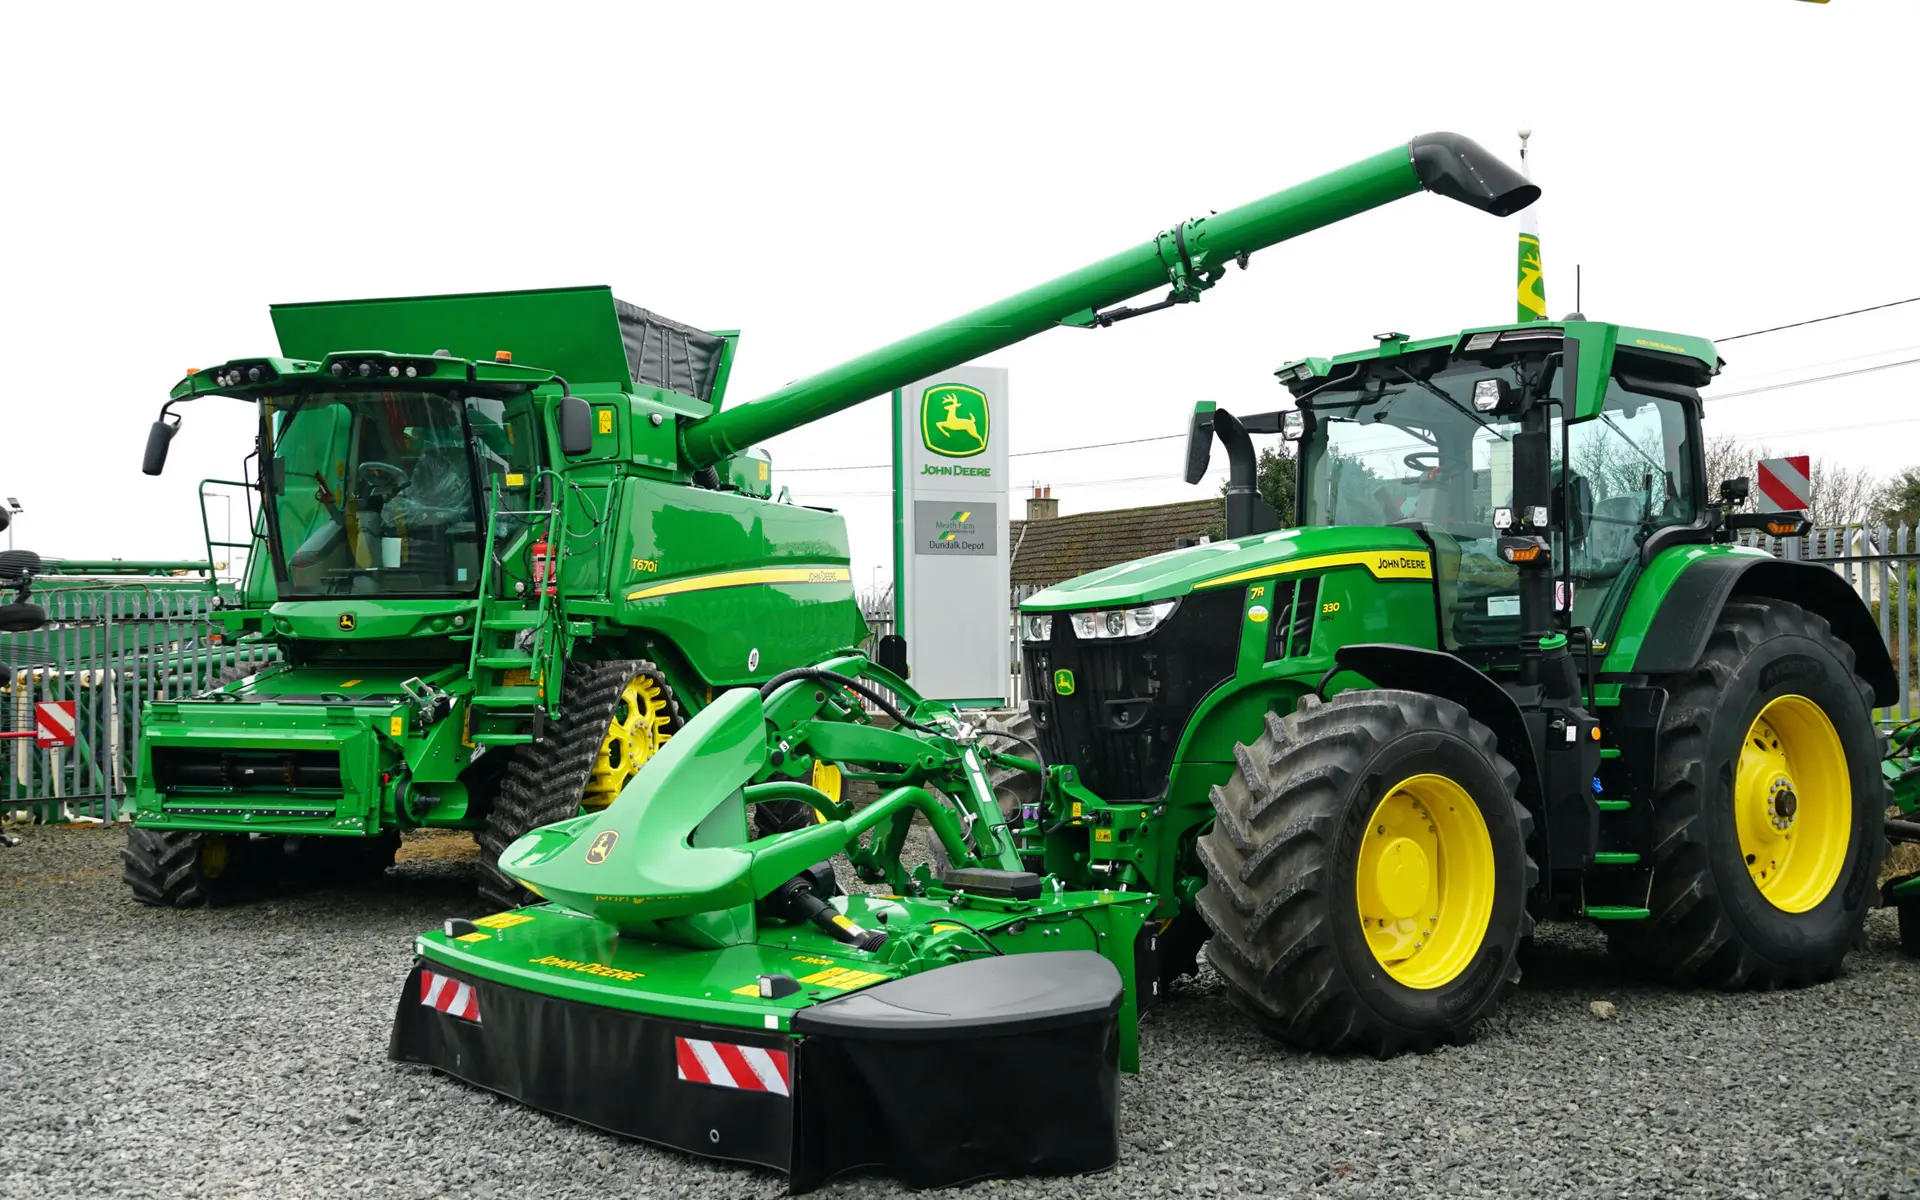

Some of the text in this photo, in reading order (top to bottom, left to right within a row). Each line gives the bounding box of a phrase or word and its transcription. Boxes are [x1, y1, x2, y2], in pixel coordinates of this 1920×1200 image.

[921, 464, 991, 477] JOHN DEERE
[936, 521, 975, 530] Meath Farm
[929, 541, 985, 551] Dundalk Depot
[632, 558, 658, 573] T670i
[1378, 557, 1426, 569] JOHN DEERE
[1250, 586, 1265, 600] 7R
[1322, 602, 1340, 613] 330
[528, 955, 647, 981] JOHN DEERE
